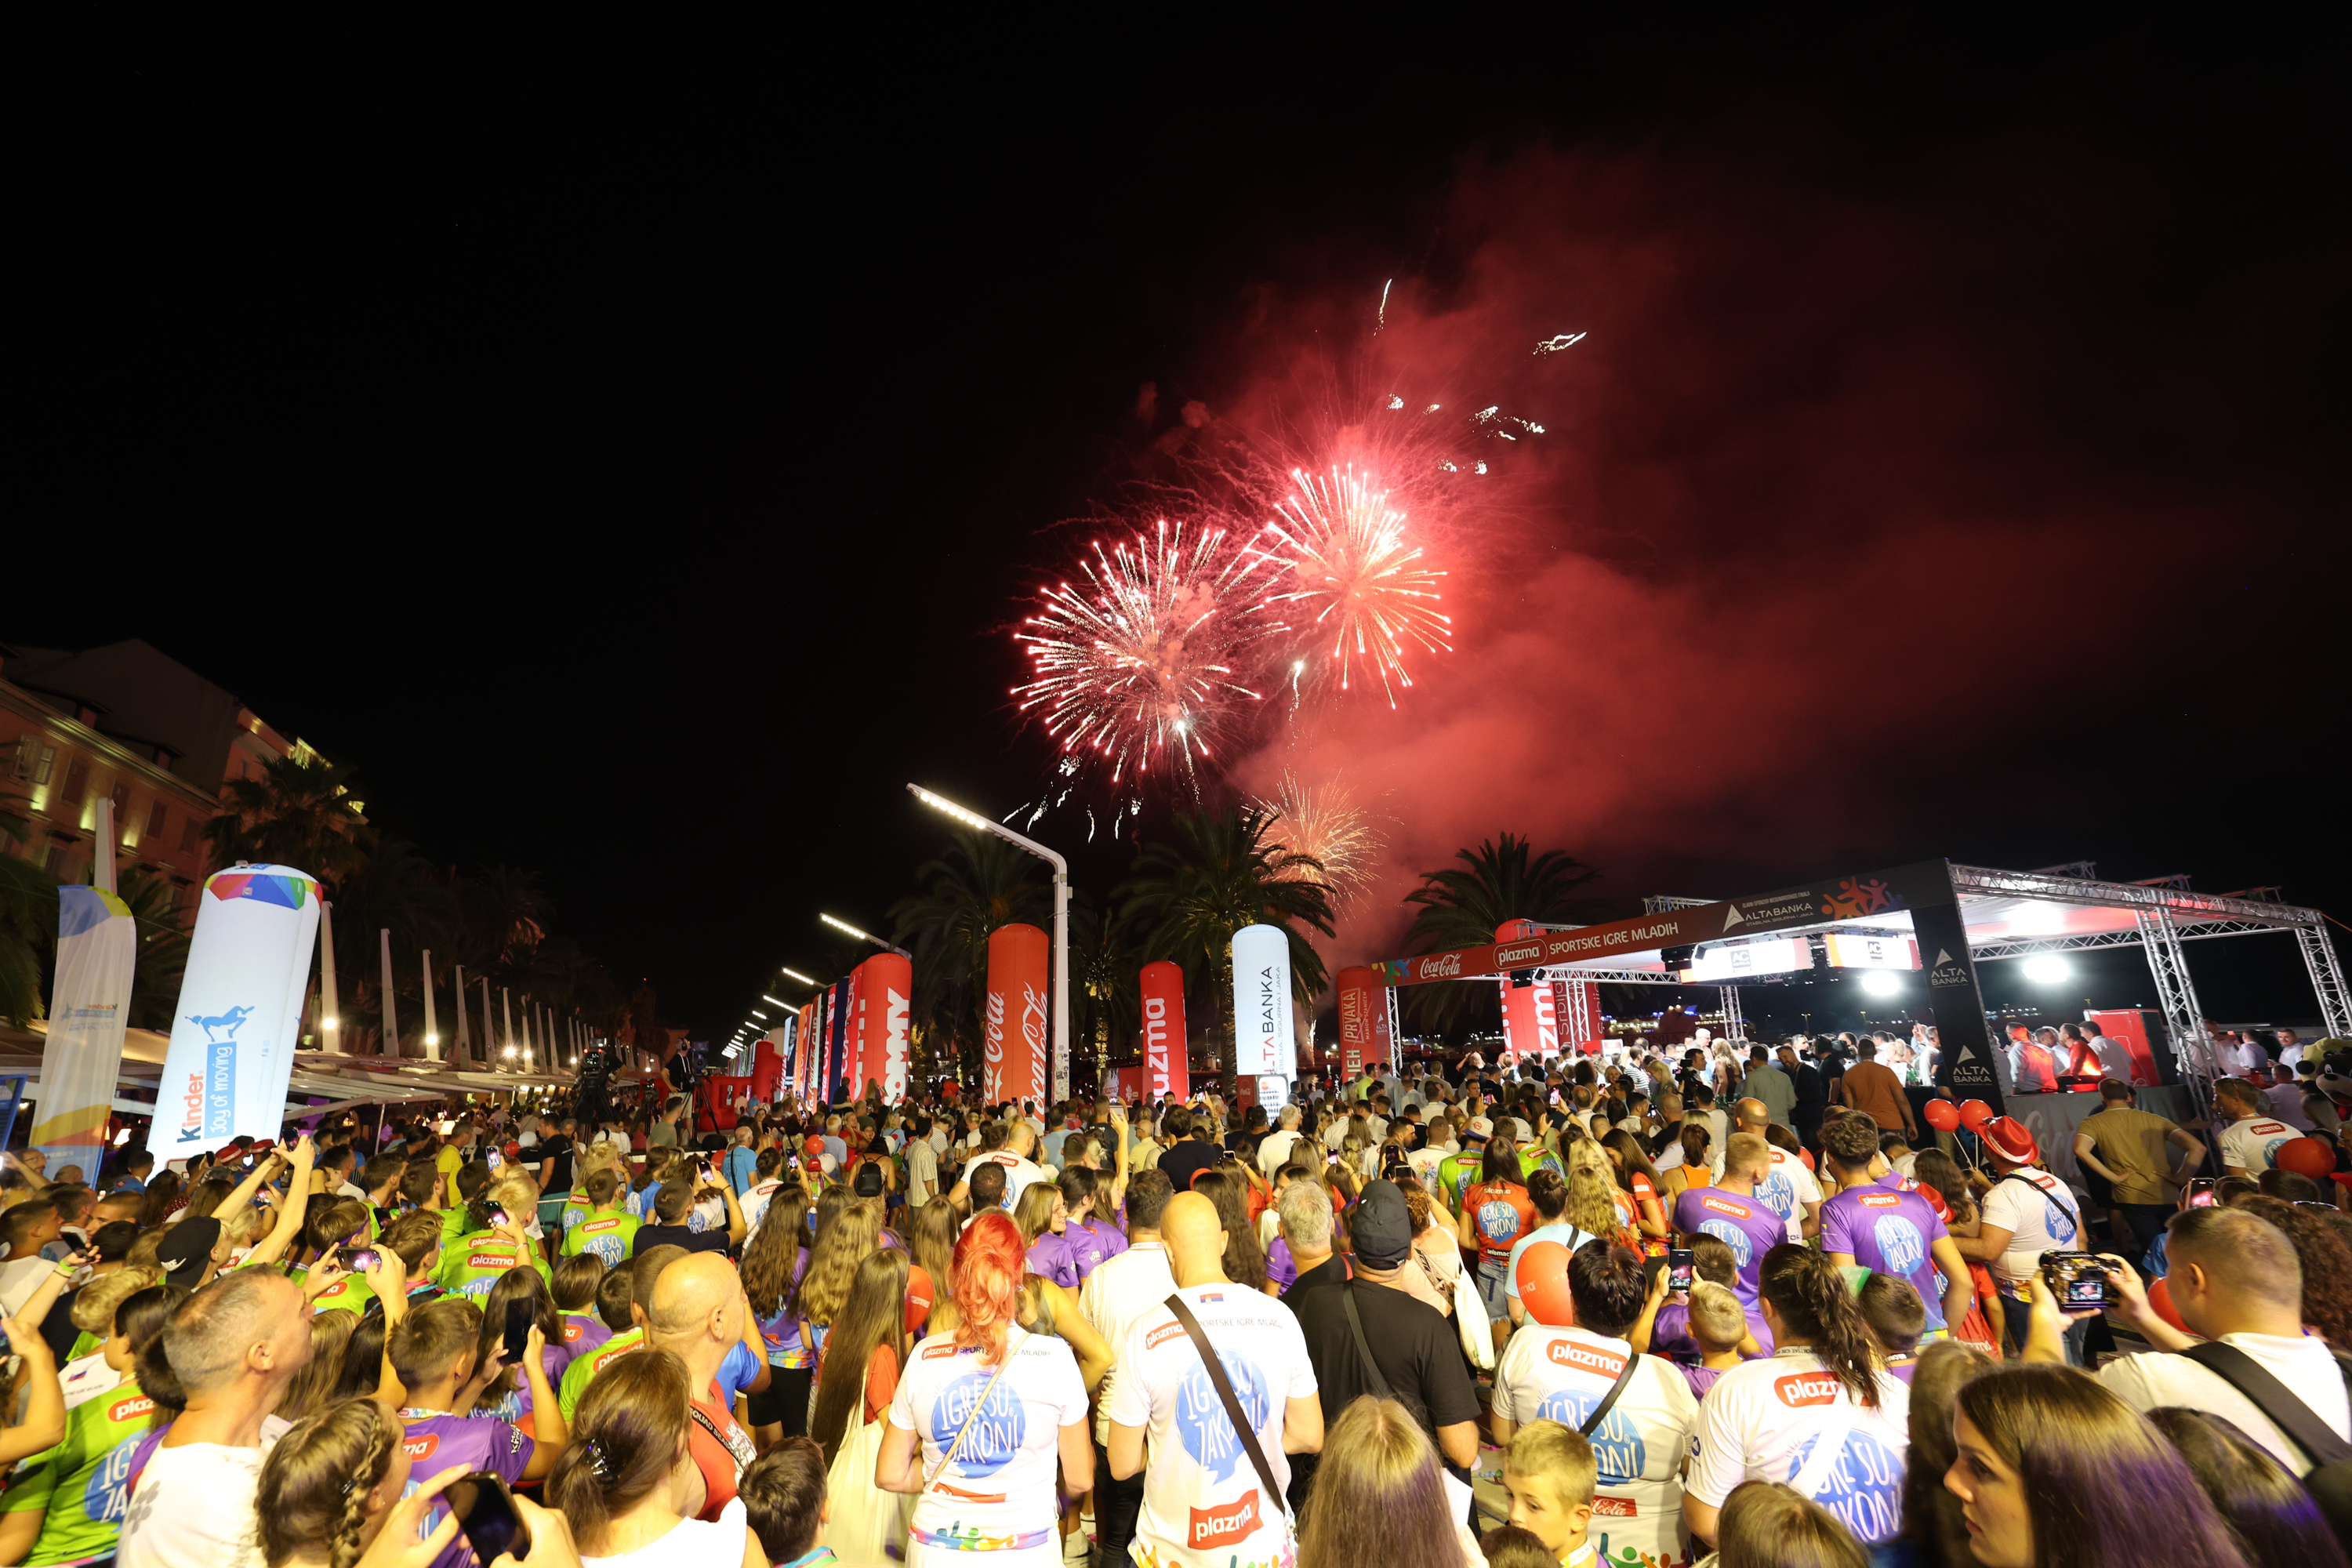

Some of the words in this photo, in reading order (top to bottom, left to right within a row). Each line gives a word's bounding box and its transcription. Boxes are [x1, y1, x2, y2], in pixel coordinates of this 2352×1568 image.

[1498, 946, 1540, 966] plazma
[1550, 935, 1601, 955] SPORTSKE
[1603, 931, 1628, 946] IGRE
[1632, 921, 1679, 942] MLADIH
[1420, 953, 1462, 979] Coca-Cola
[1931, 968, 1966, 978] ALTA
[1932, 977, 1969, 985] BANKA
[1261, 966, 1275, 1073] LTABANKA
[1343, 992, 1359, 1040] PRVAKA
[1145, 998, 1171, 1106] azma
[212, 1047, 234, 1091] moving
[1953, 1066, 1990, 1076] ALTA
[210, 1094, 228, 1107] of
[210, 1109, 231, 1134] Joy
[570, 1195, 590, 1203] plazma
[1705, 1199, 1745, 1216] plazma
[1862, 1196, 1896, 1207] plazma
[584, 1219, 616, 1232] plazma
[1485, 1218, 1518, 1239] ZAKON!
[471, 1254, 514, 1266] plazma
[1197, 1319, 1235, 1328] PORTSKE
[1146, 1323, 1185, 1349] plazma
[923, 1345, 953, 1359] plazma
[1552, 1344, 1623, 1374] plazma
[116, 1398, 154, 1421] plaz
[1853, 1439, 1891, 1486] SU
[1196, 1503, 1252, 1542] plazma
